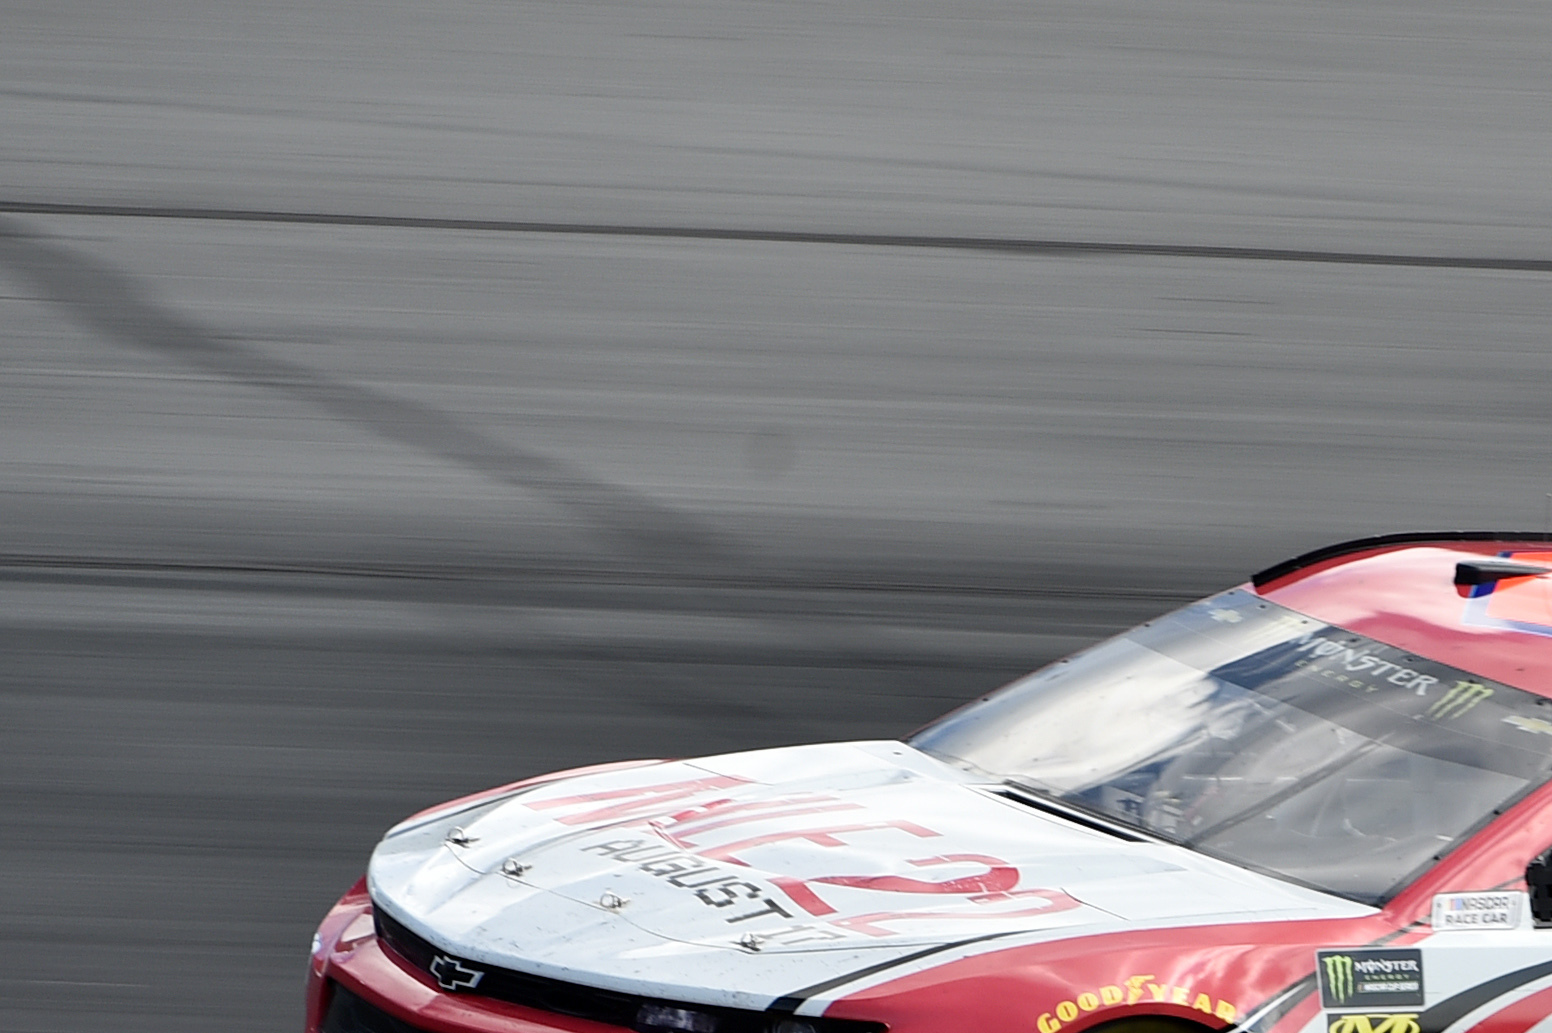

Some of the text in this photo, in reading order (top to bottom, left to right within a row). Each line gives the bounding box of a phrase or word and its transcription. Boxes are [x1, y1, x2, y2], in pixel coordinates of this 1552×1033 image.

[1297, 633, 1440, 696] MONSTER
[580, 838, 794, 924] AUGUST
[1445, 912, 1509, 925] RACE CAR
[1354, 959, 1420, 974] MONSTER
